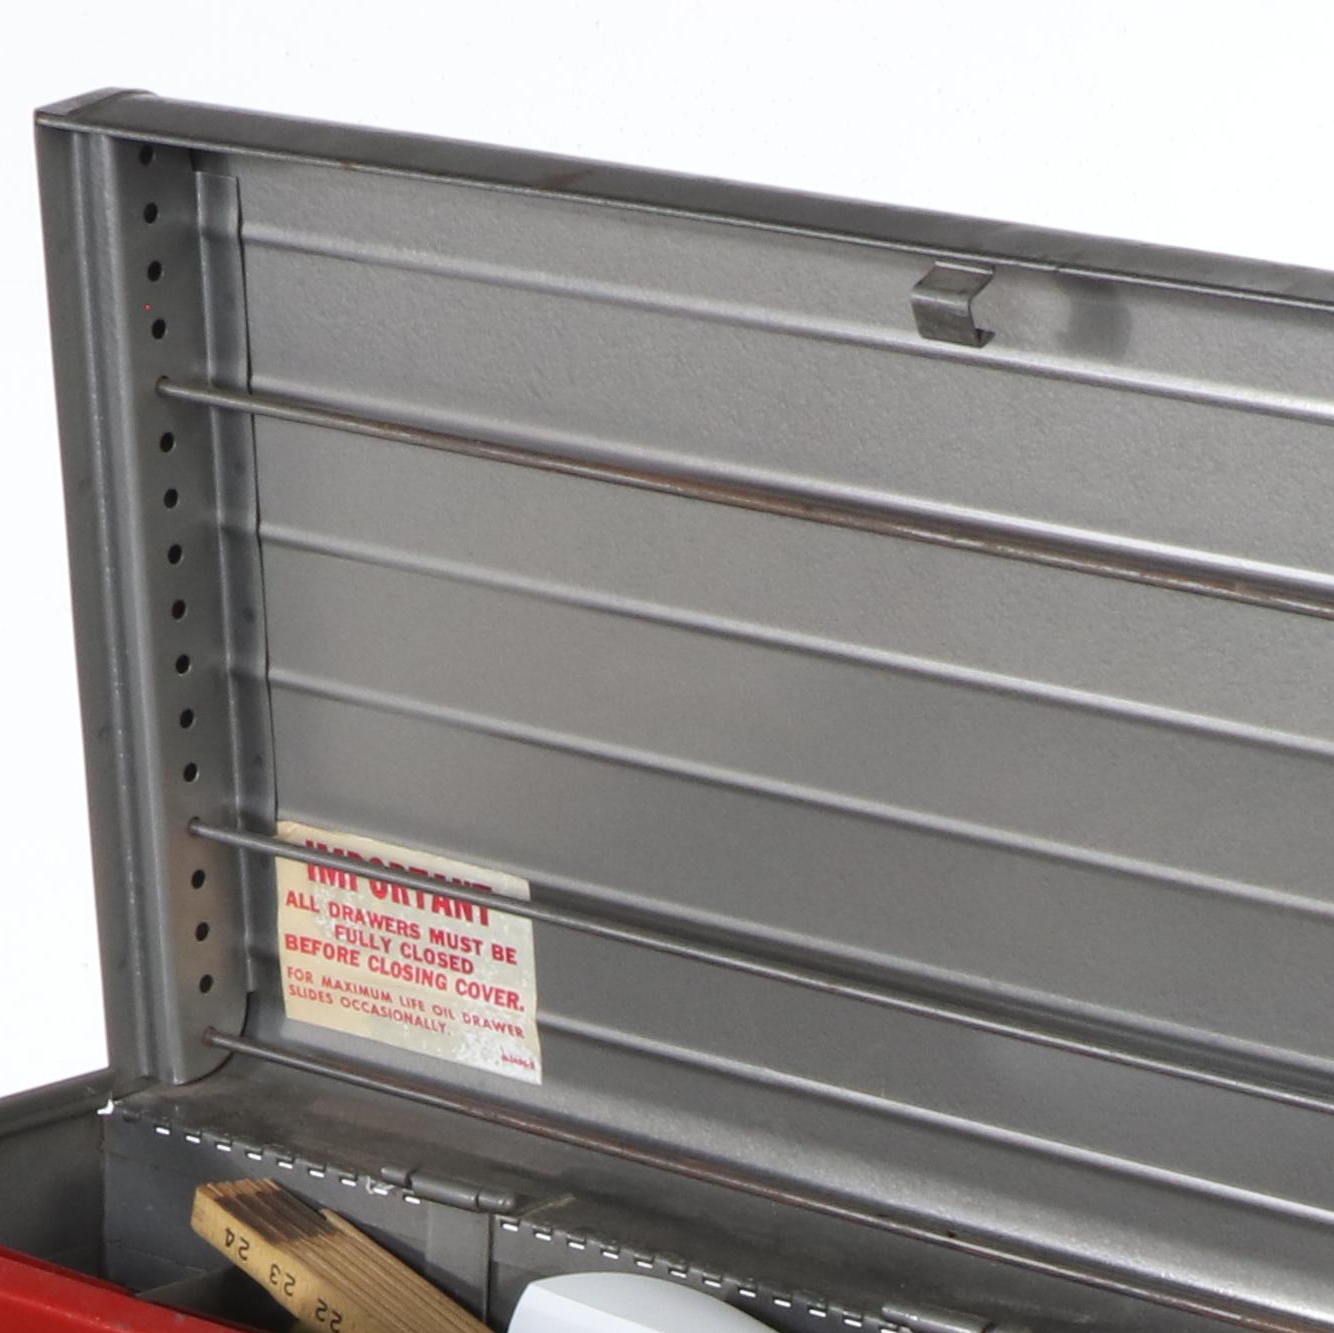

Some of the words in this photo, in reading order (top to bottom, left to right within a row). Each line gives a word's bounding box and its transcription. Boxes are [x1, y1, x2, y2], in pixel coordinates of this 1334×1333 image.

[285, 890, 320, 913] ALL
[328, 901, 421, 940] DRAWERS
[429, 928, 484, 956] MUST
[492, 945, 518, 966] BE
[334, 924, 391, 954] FULLY
[400, 942, 474, 975] CLOSED
[284, 933, 360, 968] BEFORE
[367, 955, 447, 991] CLOSING
[455, 978, 525, 1012] COVER.
[287, 966, 314, 985] FOR
[321, 974, 392, 1003] MAXIMUM
[399, 994, 425, 1012] LIFE
[432, 1003, 454, 1020] OIL
[462, 1012, 525, 1039] DRAWER
[288, 984, 334, 1006] SLIDES
[340, 997, 452, 1037] OCCASIONALLY.
[224, 1227, 251, 1262] 24
[269, 1263, 296, 1297] 23
[314, 1298, 343, 1333] 22
